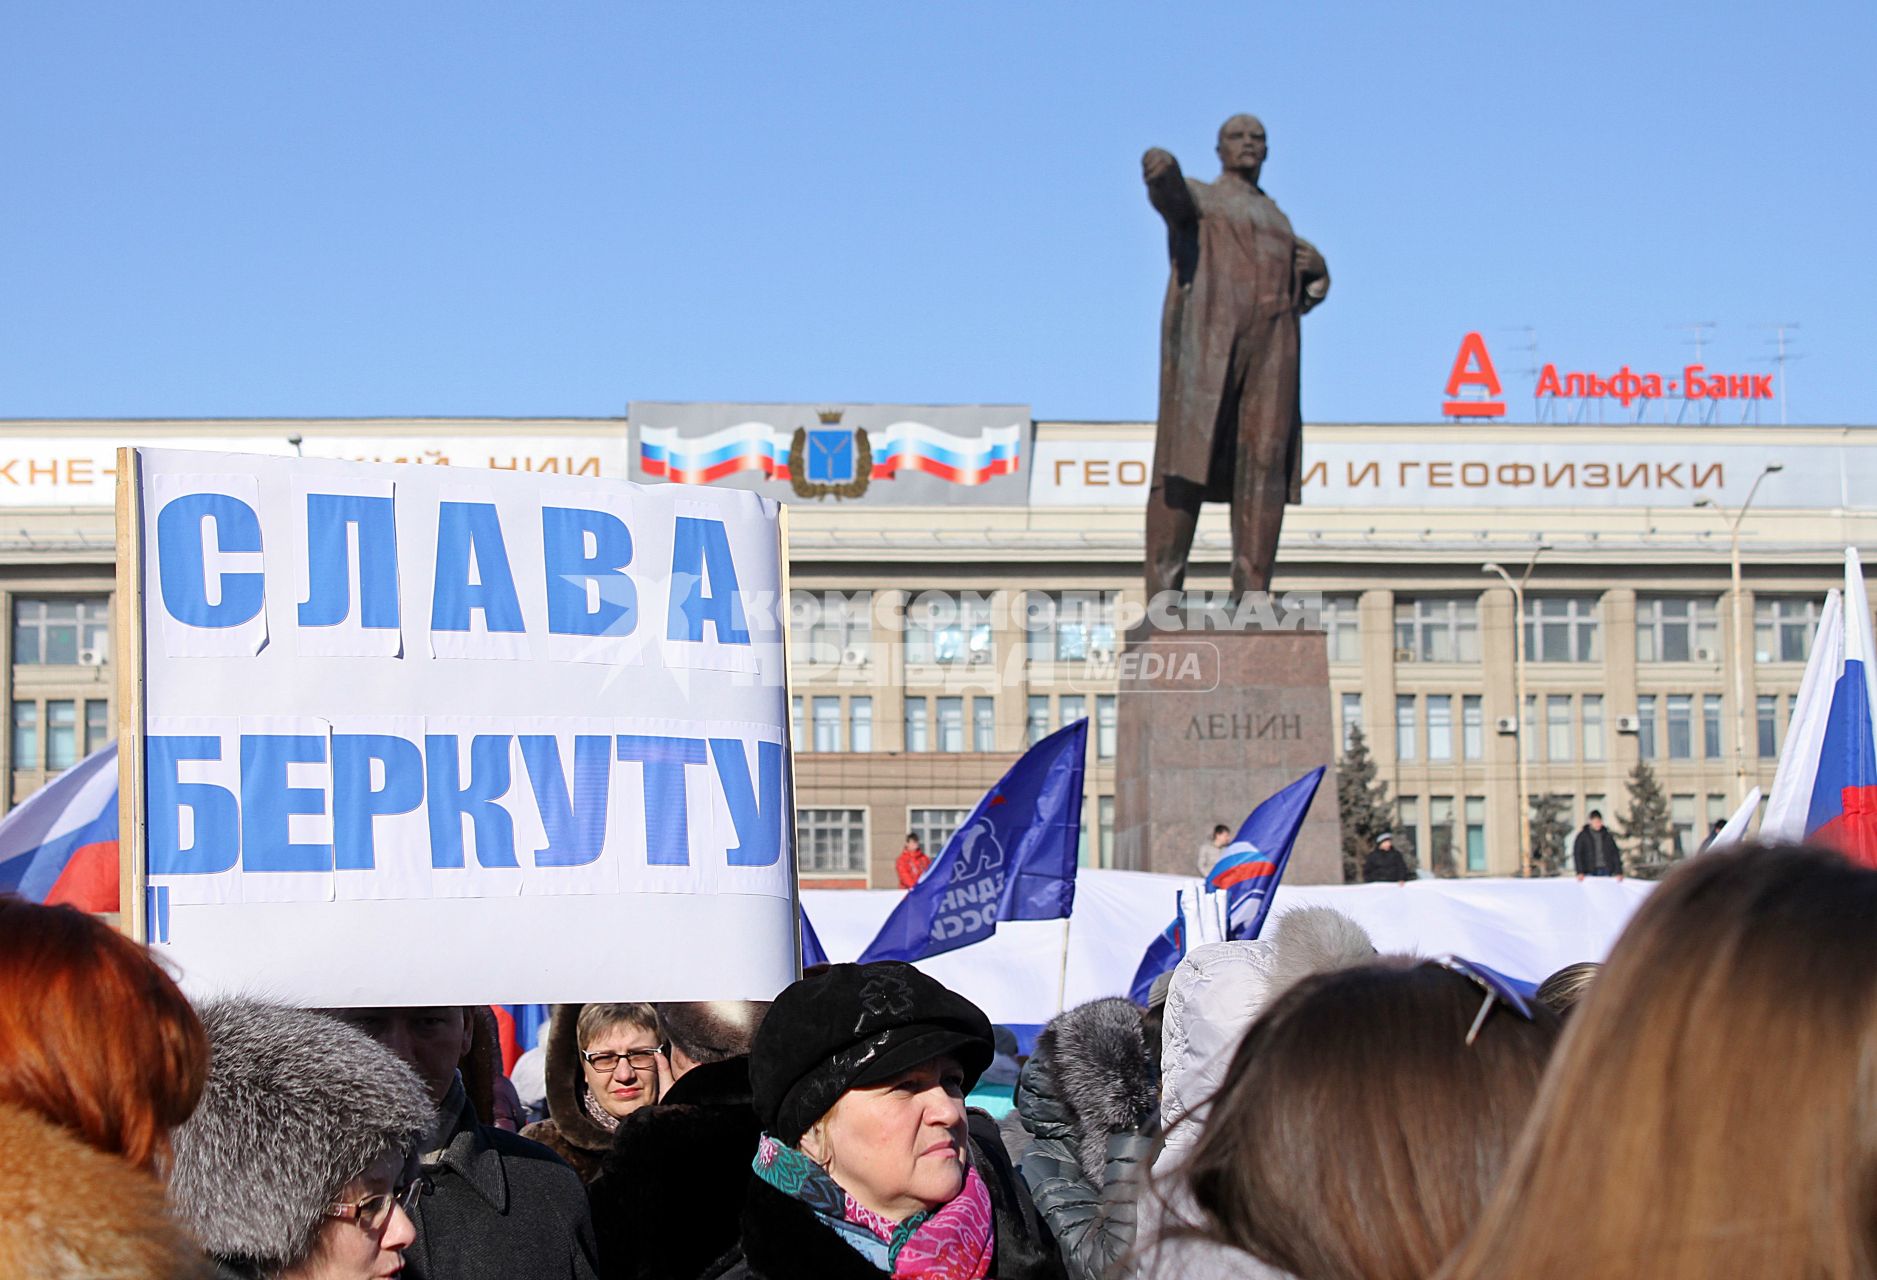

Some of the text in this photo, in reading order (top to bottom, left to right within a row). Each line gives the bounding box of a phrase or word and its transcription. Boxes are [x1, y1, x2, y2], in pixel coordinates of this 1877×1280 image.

[1400, 461, 1724, 488] ГЕОФИЗИКИ
[157, 492, 752, 646] СЛАВА
[1184, 713, 1302, 740] ЛЕНИН
[144, 734, 782, 876] БЕРКУТУ
